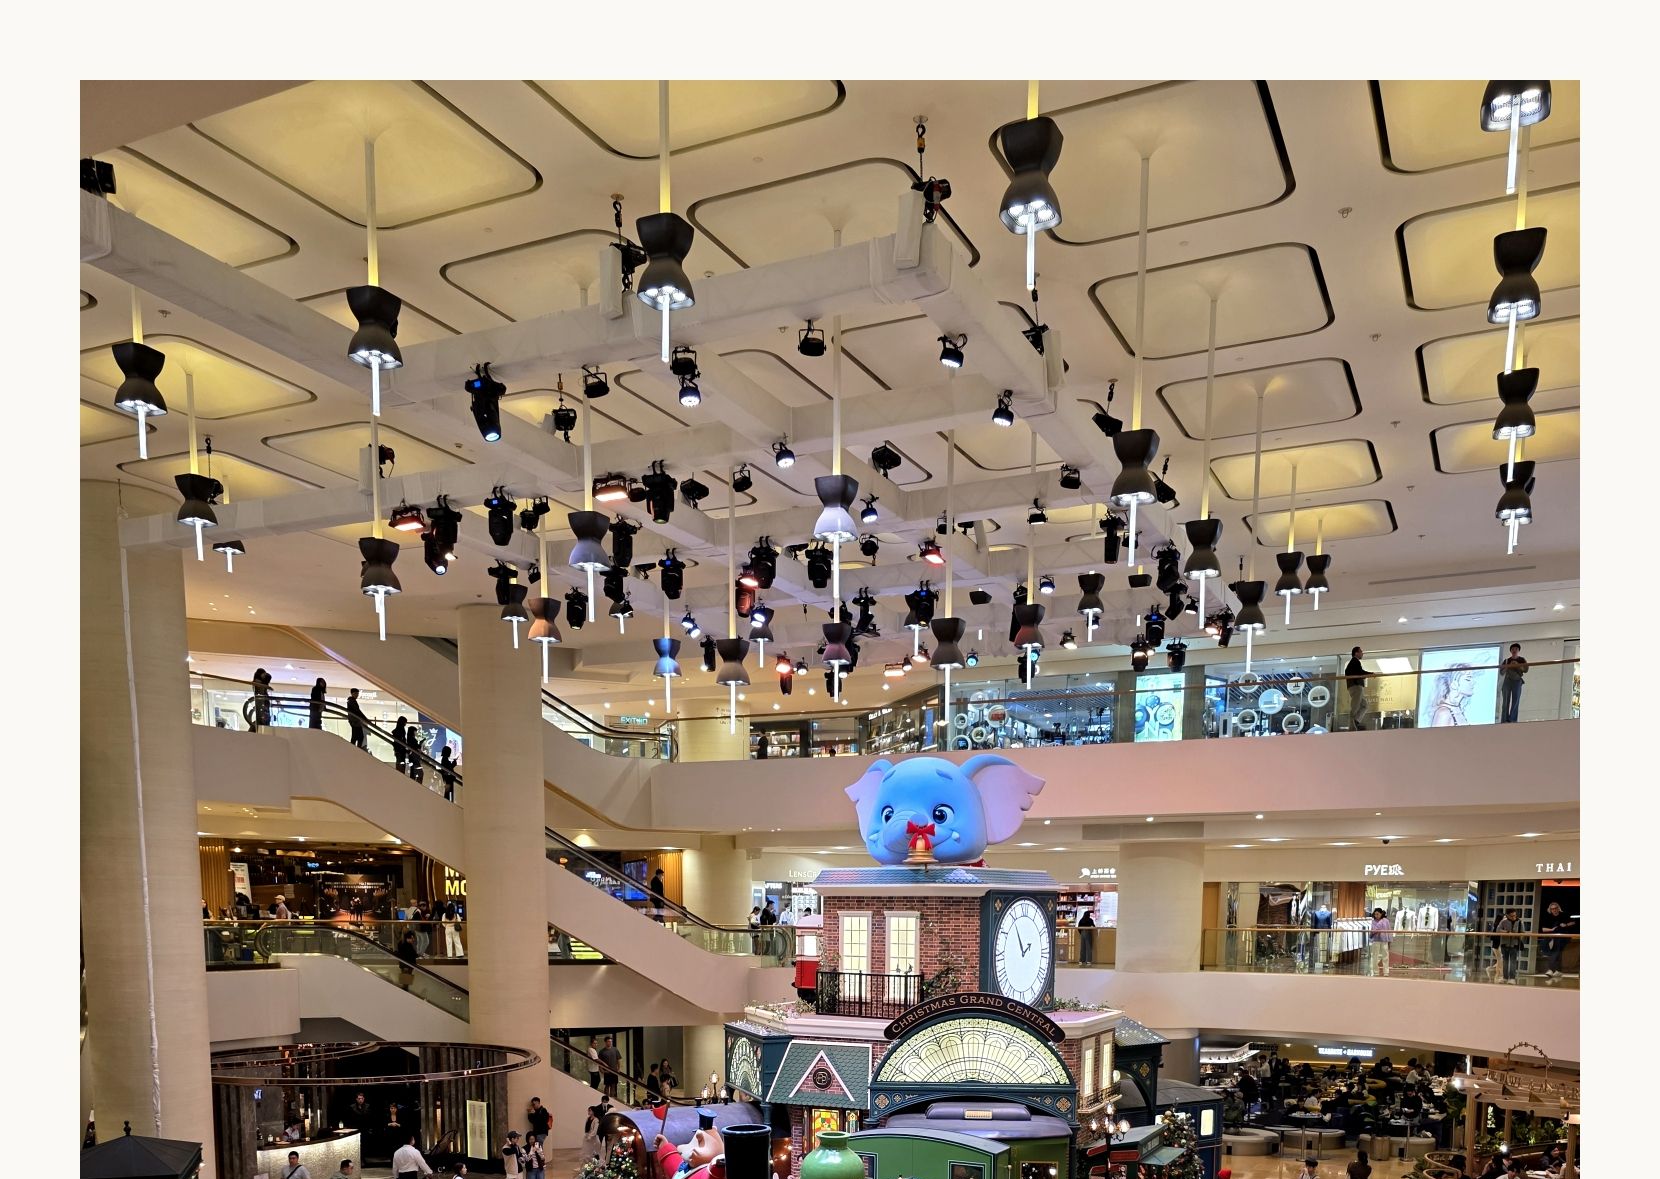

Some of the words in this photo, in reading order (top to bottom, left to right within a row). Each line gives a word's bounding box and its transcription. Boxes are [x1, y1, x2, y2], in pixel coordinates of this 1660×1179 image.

[1535, 862, 1572, 873] THAI
[891, 997, 956, 1034] CHRISTMAS
[959, 995, 1003, 1007] GRAND
[1006, 1002, 1056, 1037] CENTRAL
